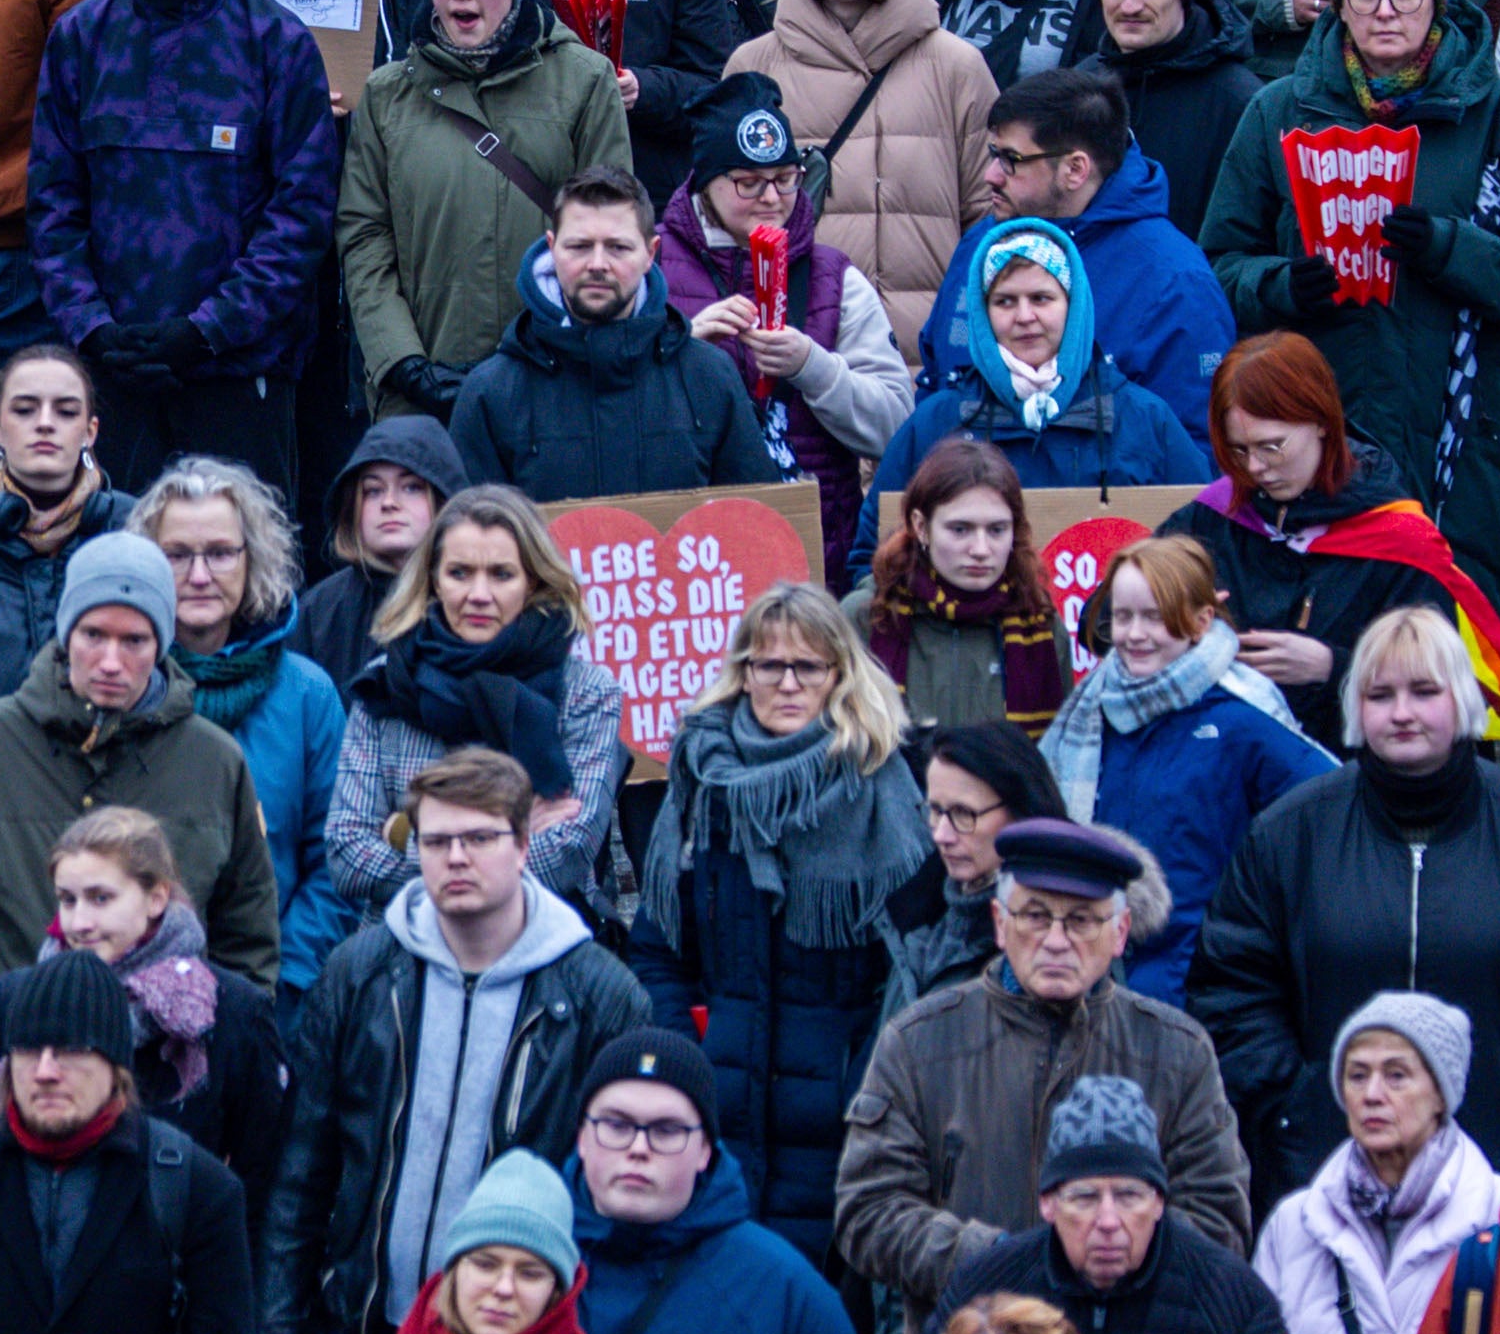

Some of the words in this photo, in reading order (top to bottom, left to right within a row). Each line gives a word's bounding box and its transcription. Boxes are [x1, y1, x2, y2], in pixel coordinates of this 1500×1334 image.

[570, 539, 657, 585] LEBE
[586, 578, 677, 622] DASS
[687, 573, 745, 615] DIE
